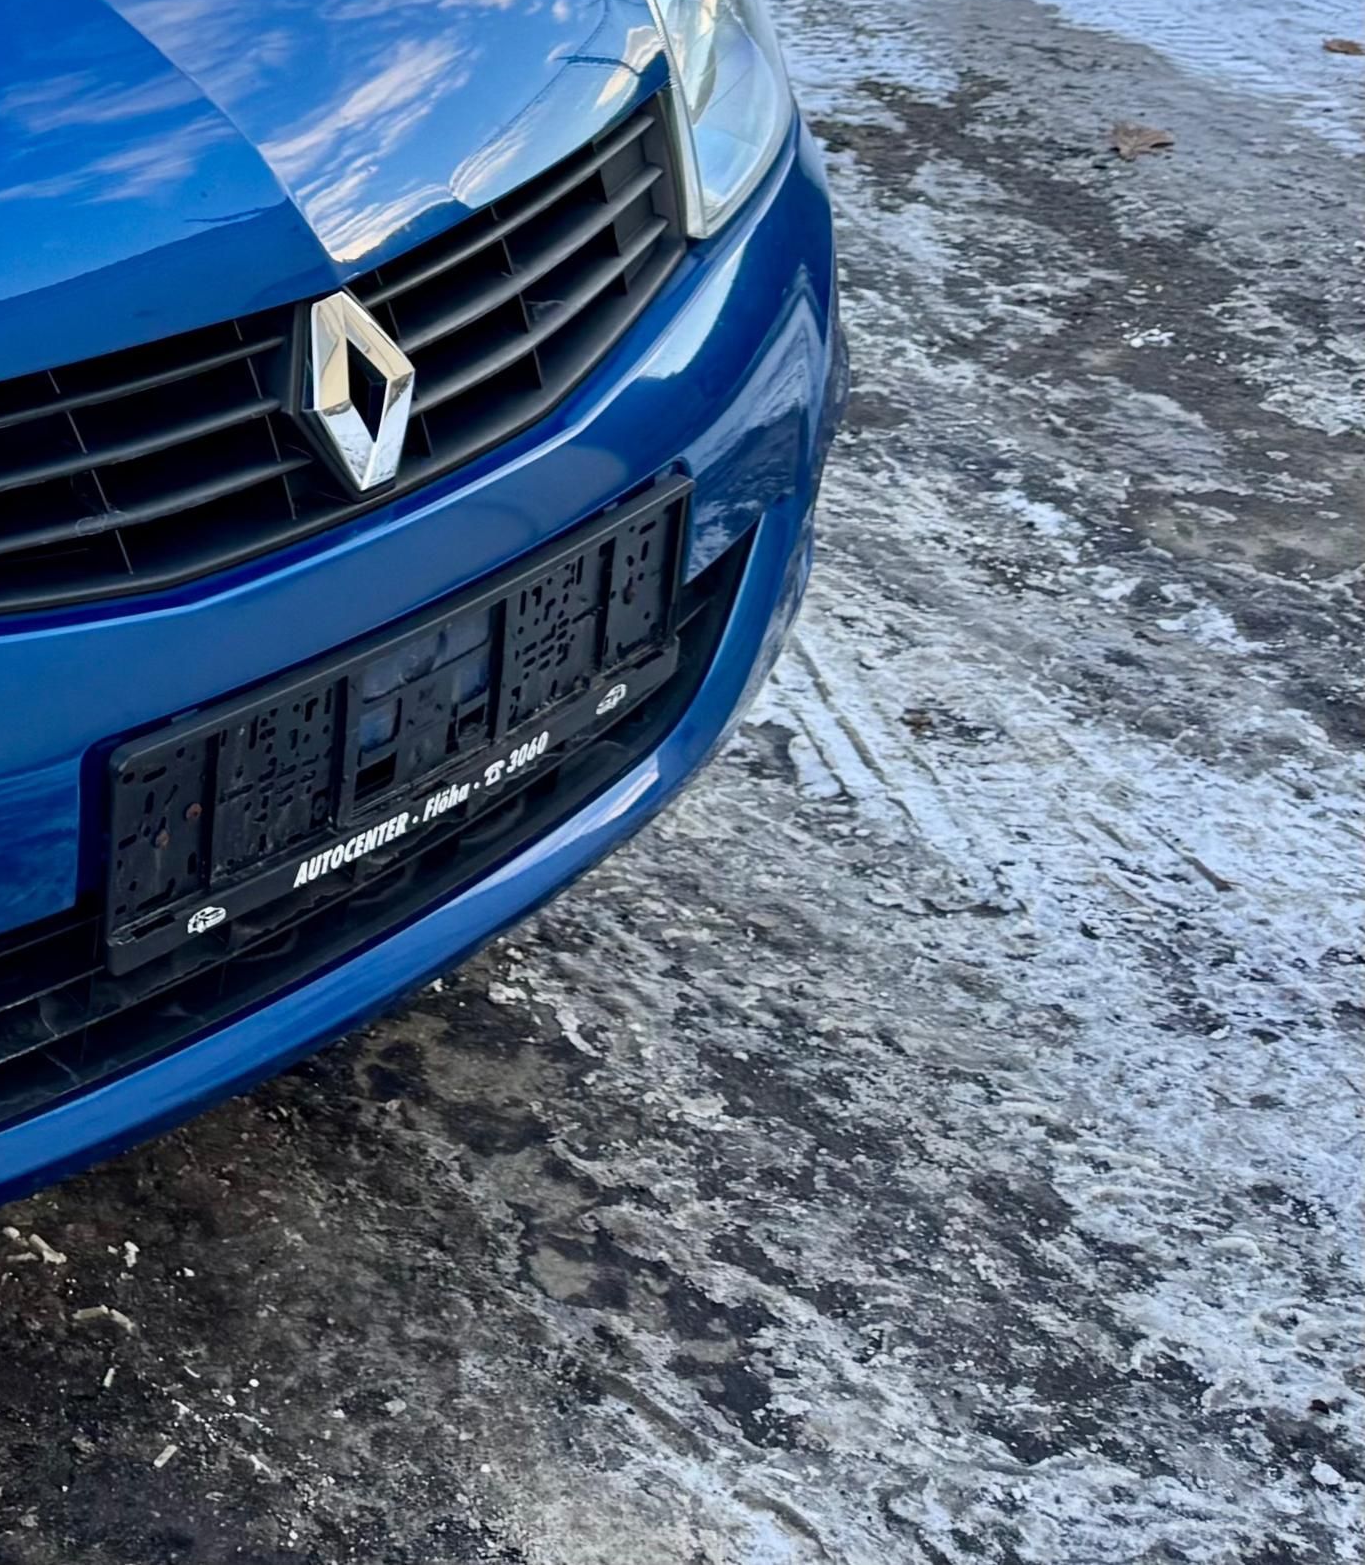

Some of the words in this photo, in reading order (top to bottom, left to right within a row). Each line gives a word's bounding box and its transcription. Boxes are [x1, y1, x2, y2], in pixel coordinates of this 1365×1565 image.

[293, 811, 410, 889] AUTOCENTER
[422, 781, 471, 823] Flöha
[505, 730, 550, 774] 3060
